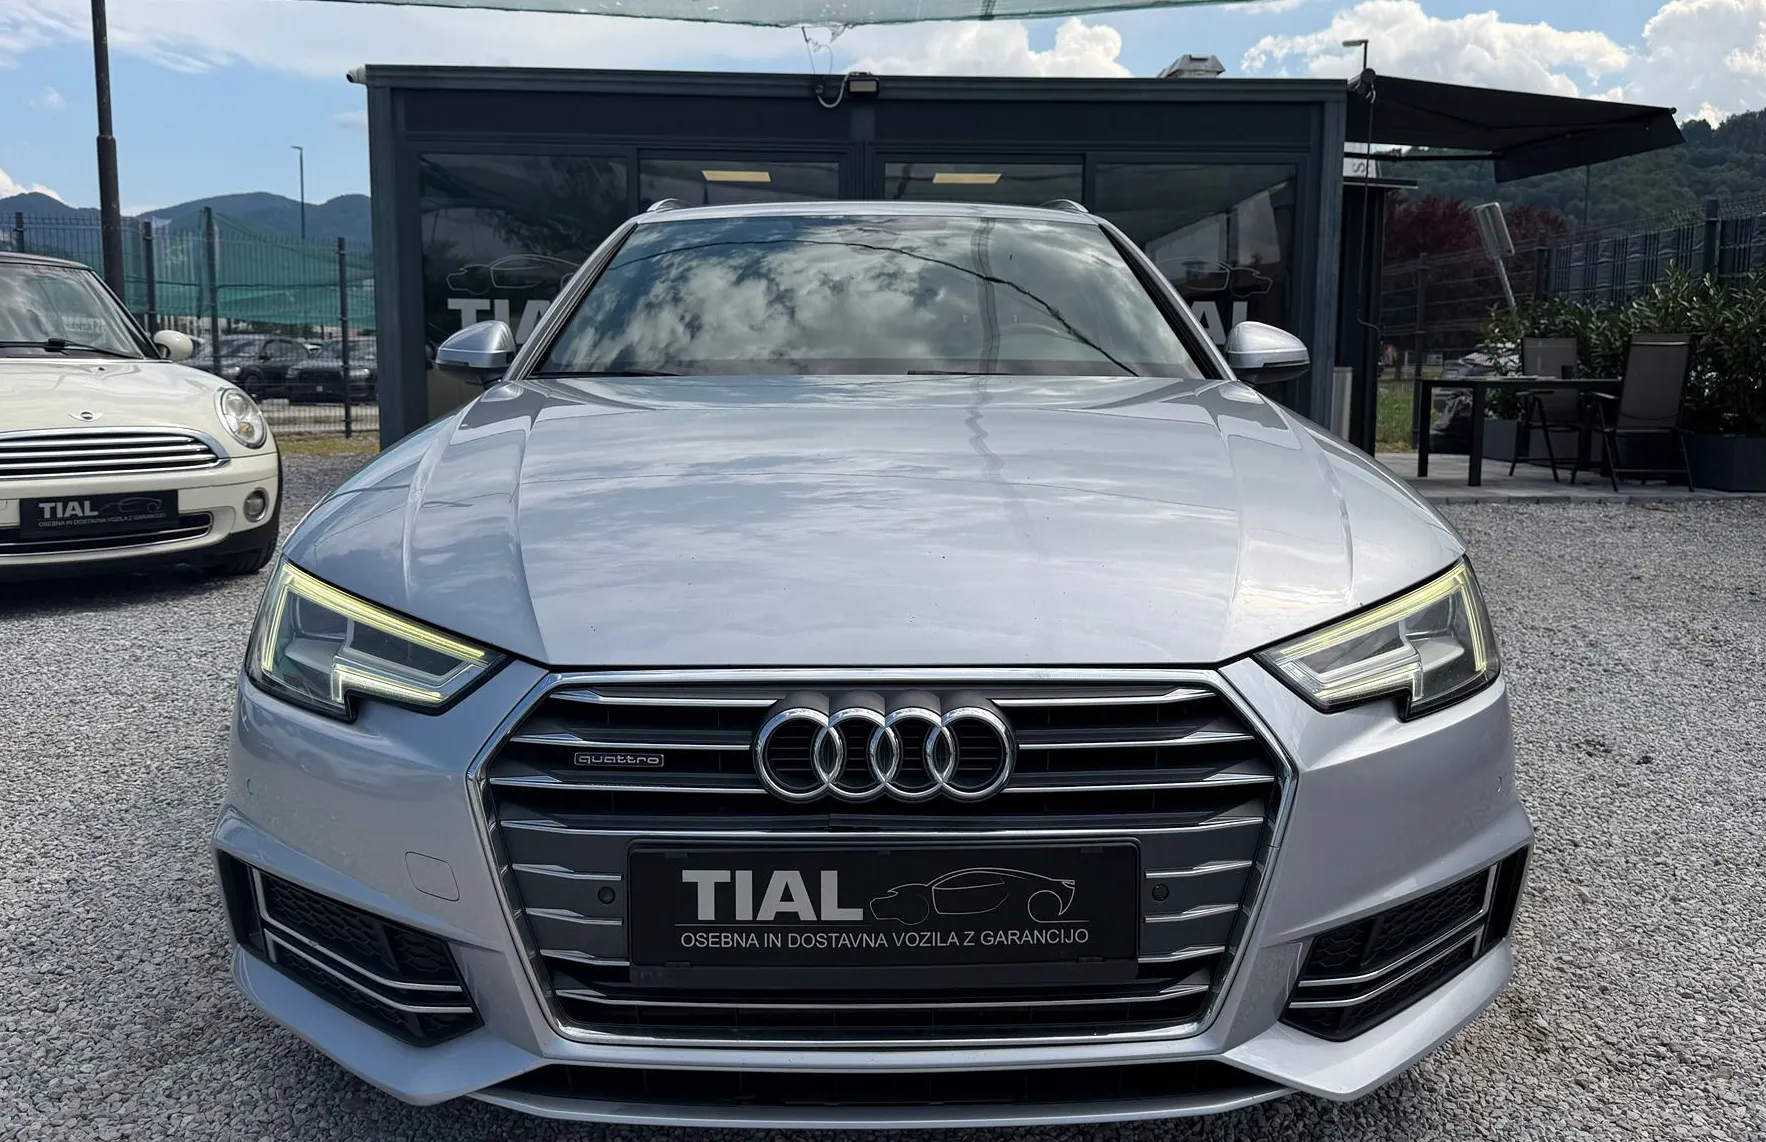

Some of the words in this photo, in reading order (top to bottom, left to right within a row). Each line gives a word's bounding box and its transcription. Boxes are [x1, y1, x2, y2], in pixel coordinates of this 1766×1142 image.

[38, 501, 99, 519] TIAL
[579, 755, 660, 764] quattro
[682, 870, 864, 921] TIAL
[681, 932, 760, 948] OSEBNA
[764, 933, 781, 948] IN
[788, 932, 889, 949] DOSTAVNA
[892, 931, 960, 947] VOZILA
[963, 931, 975, 946] Z
[980, 928, 1089, 946] GARANCIJO
